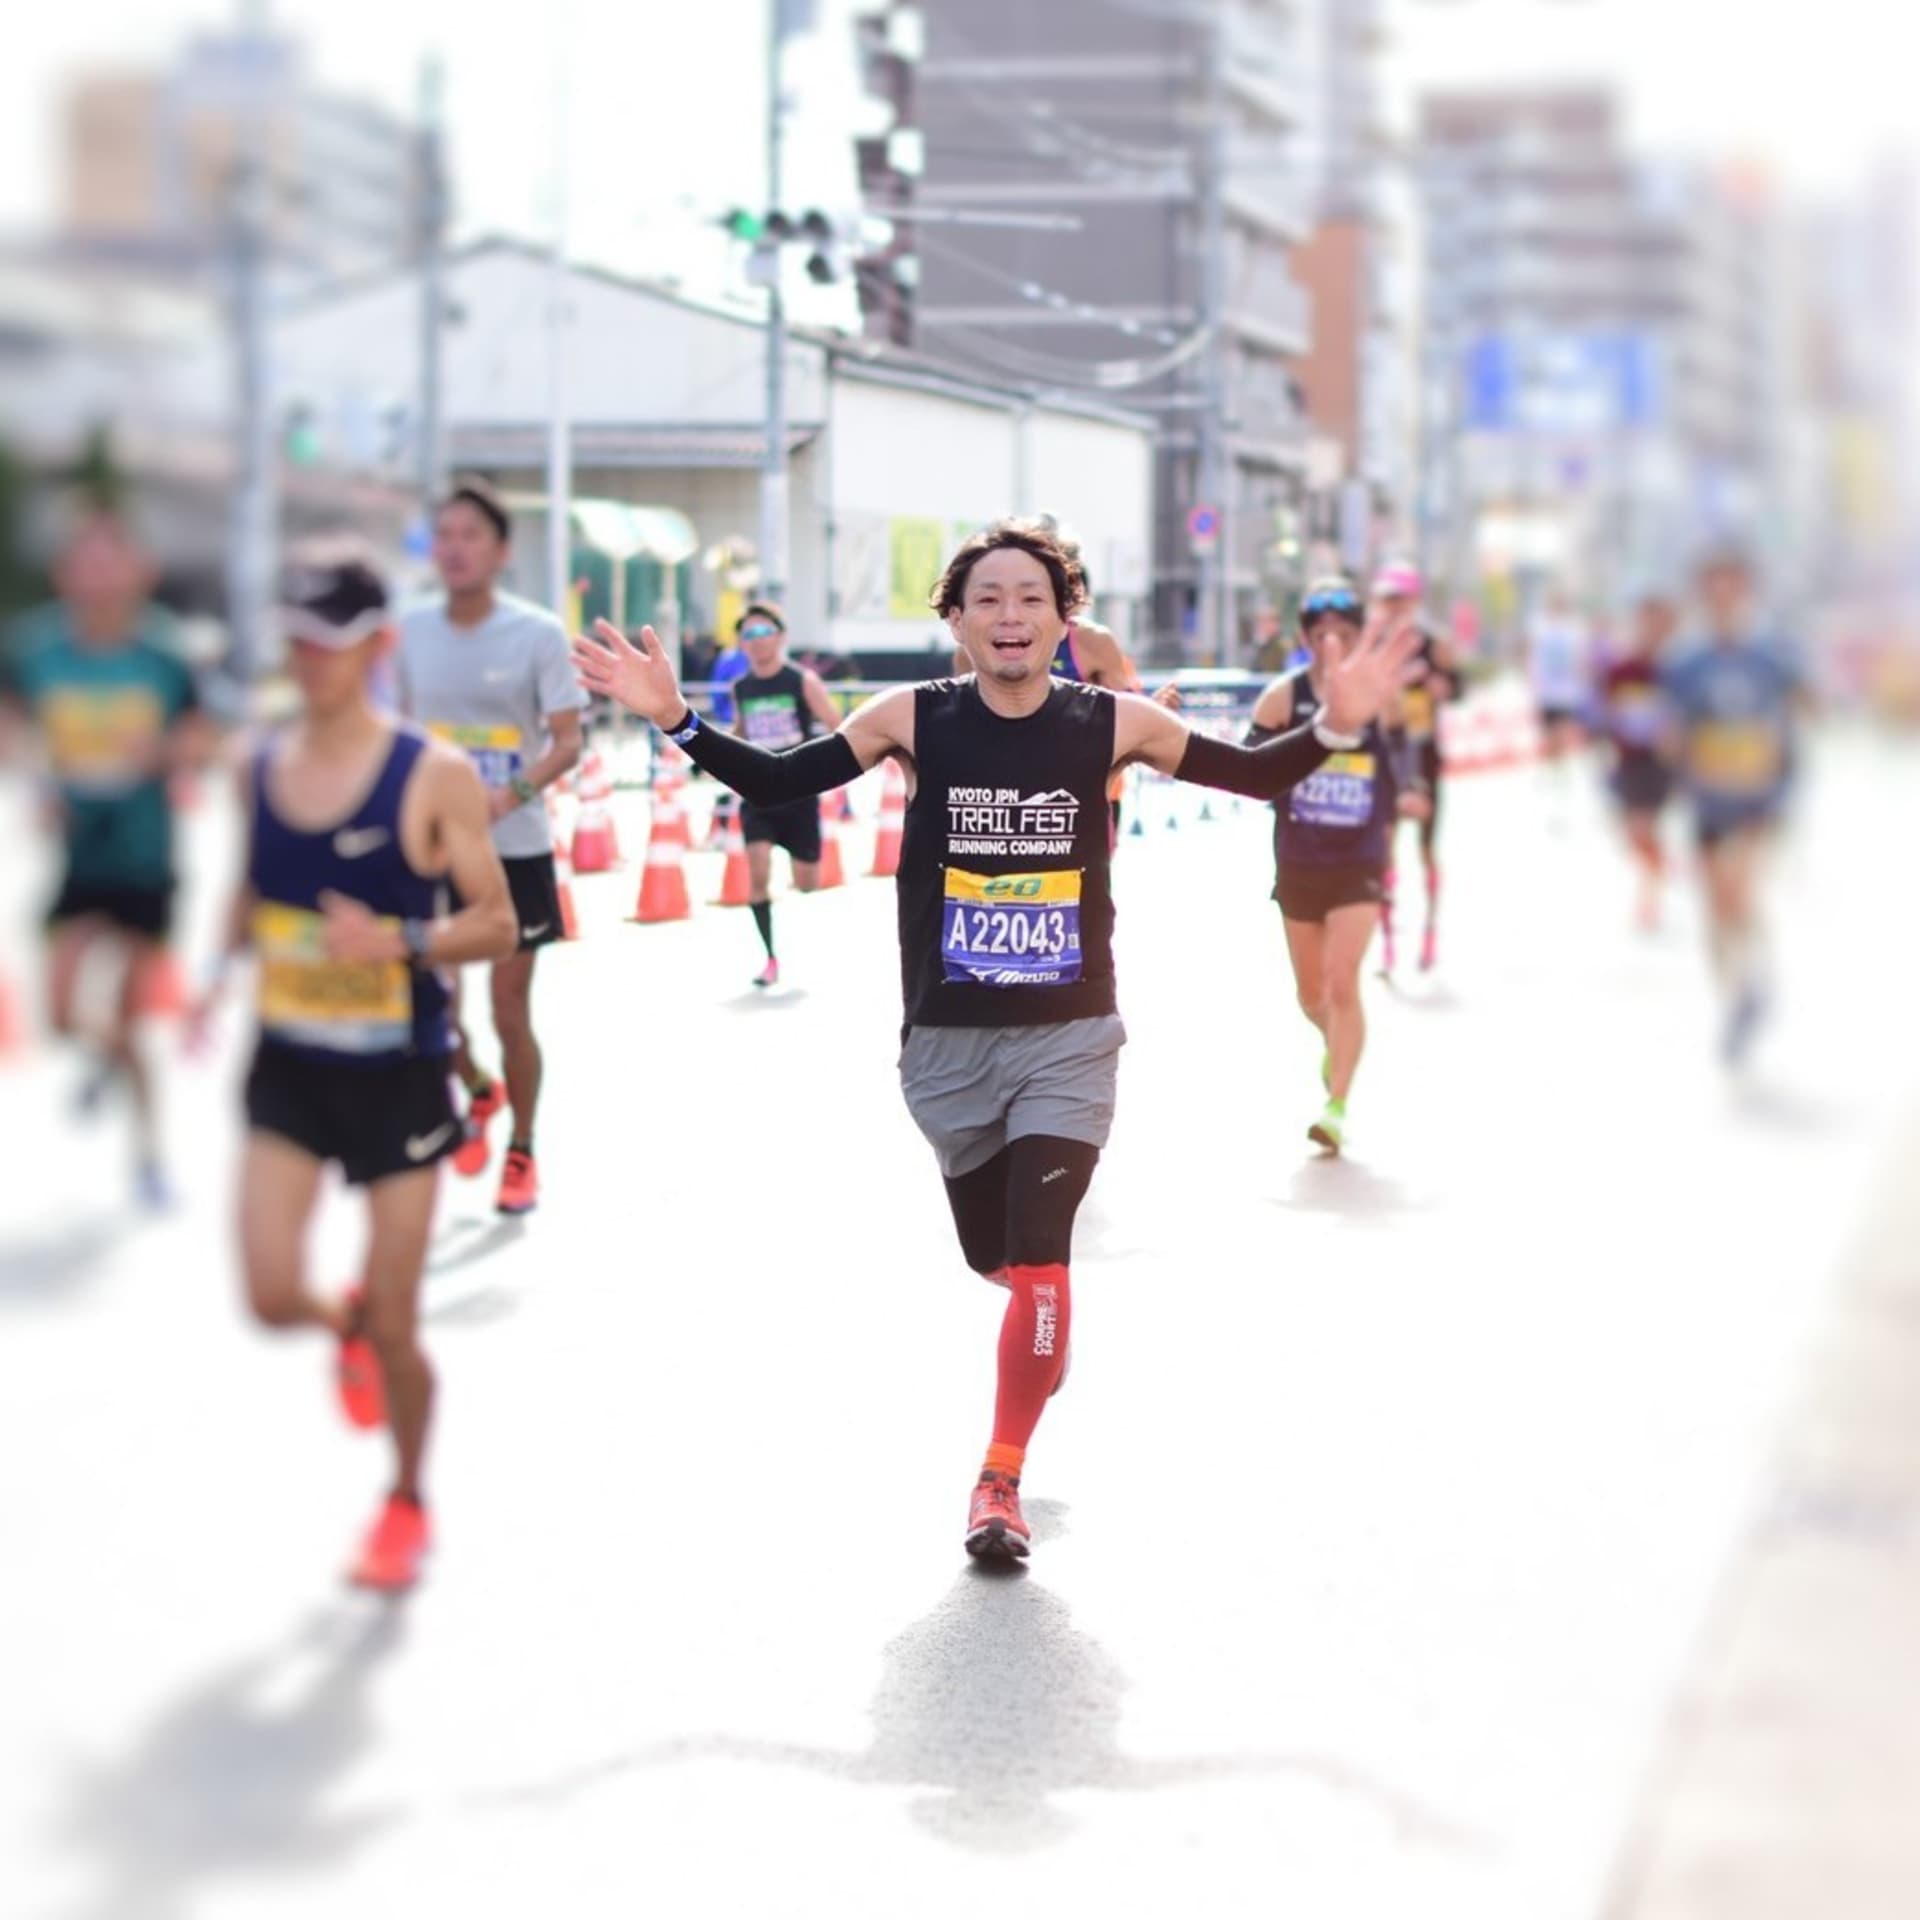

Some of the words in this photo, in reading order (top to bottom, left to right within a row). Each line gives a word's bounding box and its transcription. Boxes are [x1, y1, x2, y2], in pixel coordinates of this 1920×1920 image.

[948, 786, 992, 802] KYOTO
[995, 788, 1019, 803] JPN
[947, 807, 1014, 833] TRAIL
[1020, 808, 1079, 833] FEST
[948, 840, 1007, 855] RUNNING
[1010, 840, 1072, 855] COMPANY
[947, 907, 1066, 955] A22043
